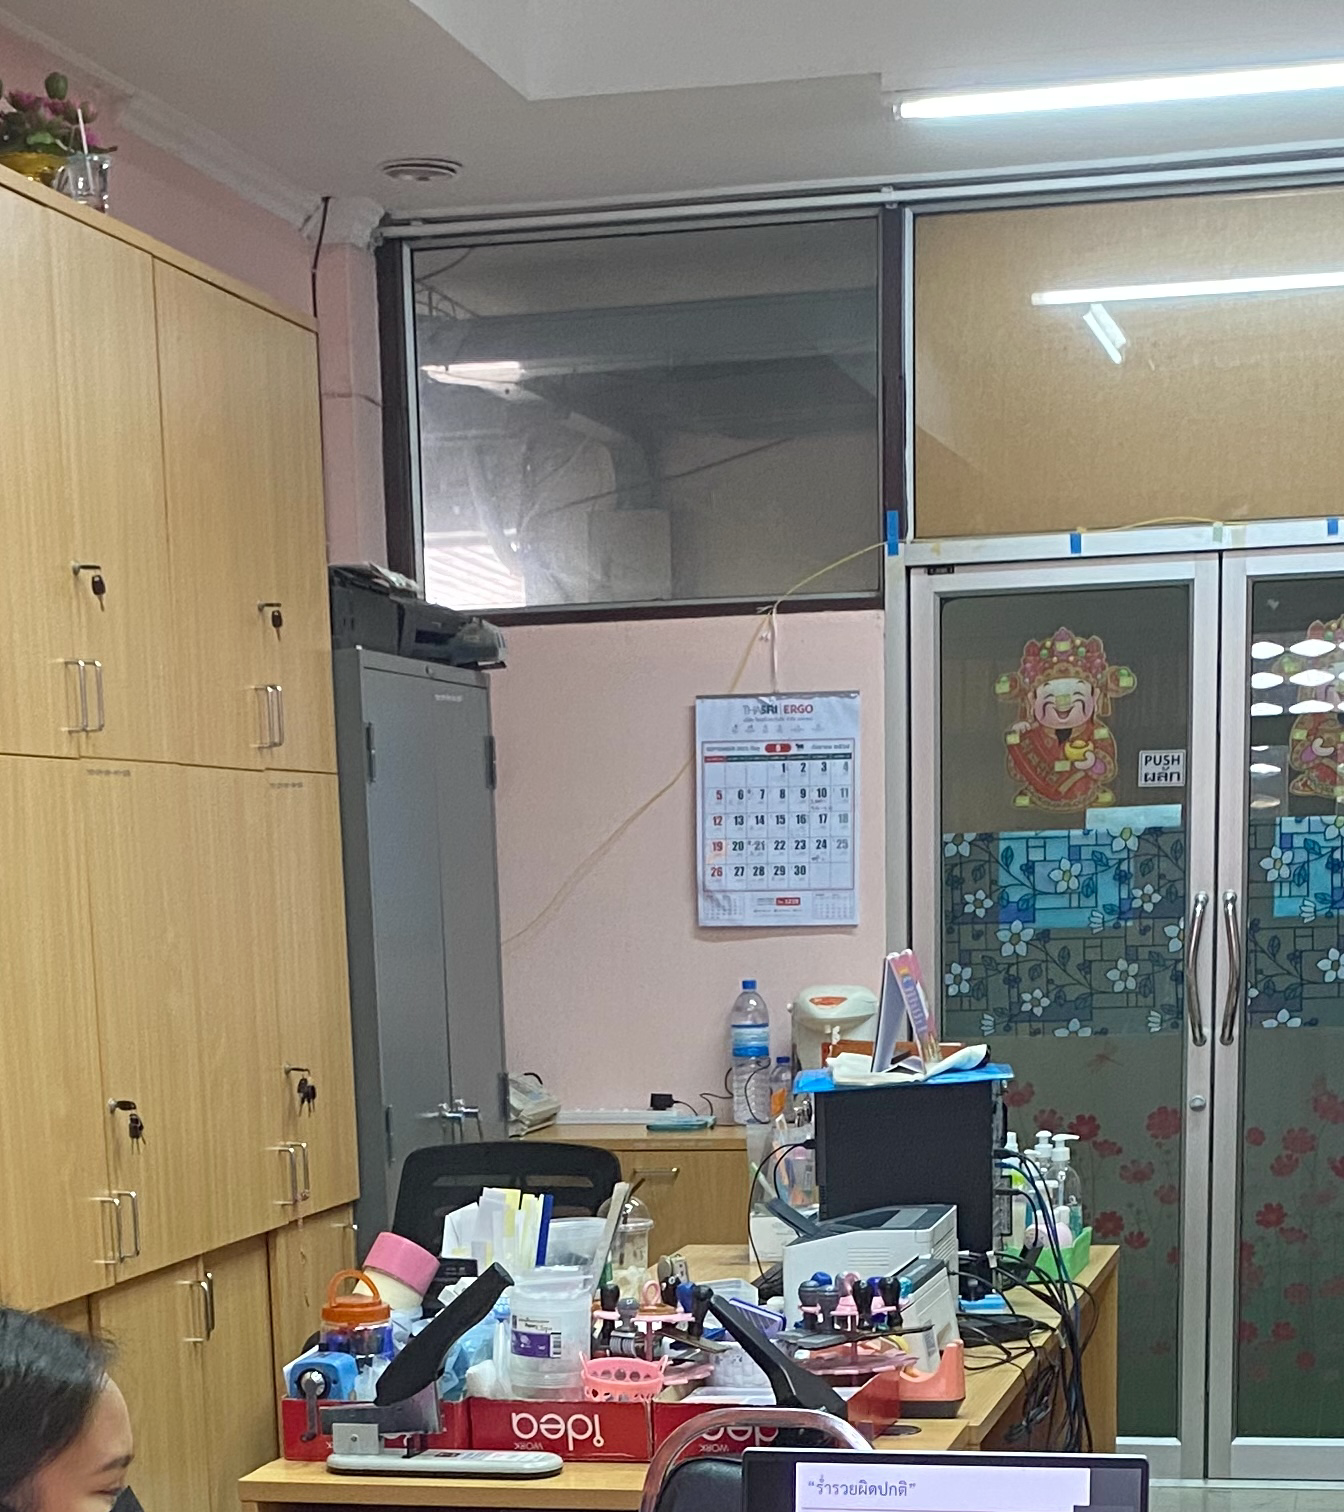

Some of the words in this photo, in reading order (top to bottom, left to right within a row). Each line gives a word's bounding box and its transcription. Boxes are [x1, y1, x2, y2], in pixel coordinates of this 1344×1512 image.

[783, 704, 814, 714] ERGO
[1144, 754, 1181, 766] PUSH
[781, 763, 786, 773] 1
[799, 763, 806, 773] 2
[820, 763, 827, 773] 3
[1143, 766, 1181, 783] ผลัก
[716, 790, 723, 800] 5
[737, 789, 744, 800] 6
[759, 789, 765, 799] 7
[779, 789, 786, 799] 8
[800, 789, 806, 799] 9
[817, 788, 828, 798] 10
[840, 788, 849, 798] 11
[713, 816, 723, 826] 12
[734, 815, 744, 826] 13
[754, 815, 765, 825] 14
[775, 815, 786, 825] 15
[796, 814, 806, 824] 16
[818, 814, 828, 824] 17
[712, 841, 723, 852] 19
[732, 841, 744, 851] 20
[773, 840, 786, 850] 22
[794, 840, 806, 850] 23
[815, 839, 828, 850] 24
[710, 866, 723, 877] 26
[734, 866, 745, 877] 27
[752, 866, 765, 876] 28
[773, 865, 786, 876] 29
[794, 865, 806, 876] 30
[511, 1412, 604, 1451] idea
[514, 1441, 544, 1451] WORK
[807, 1475, 917, 1497] “ร่ำรวยผิดปกติ”
